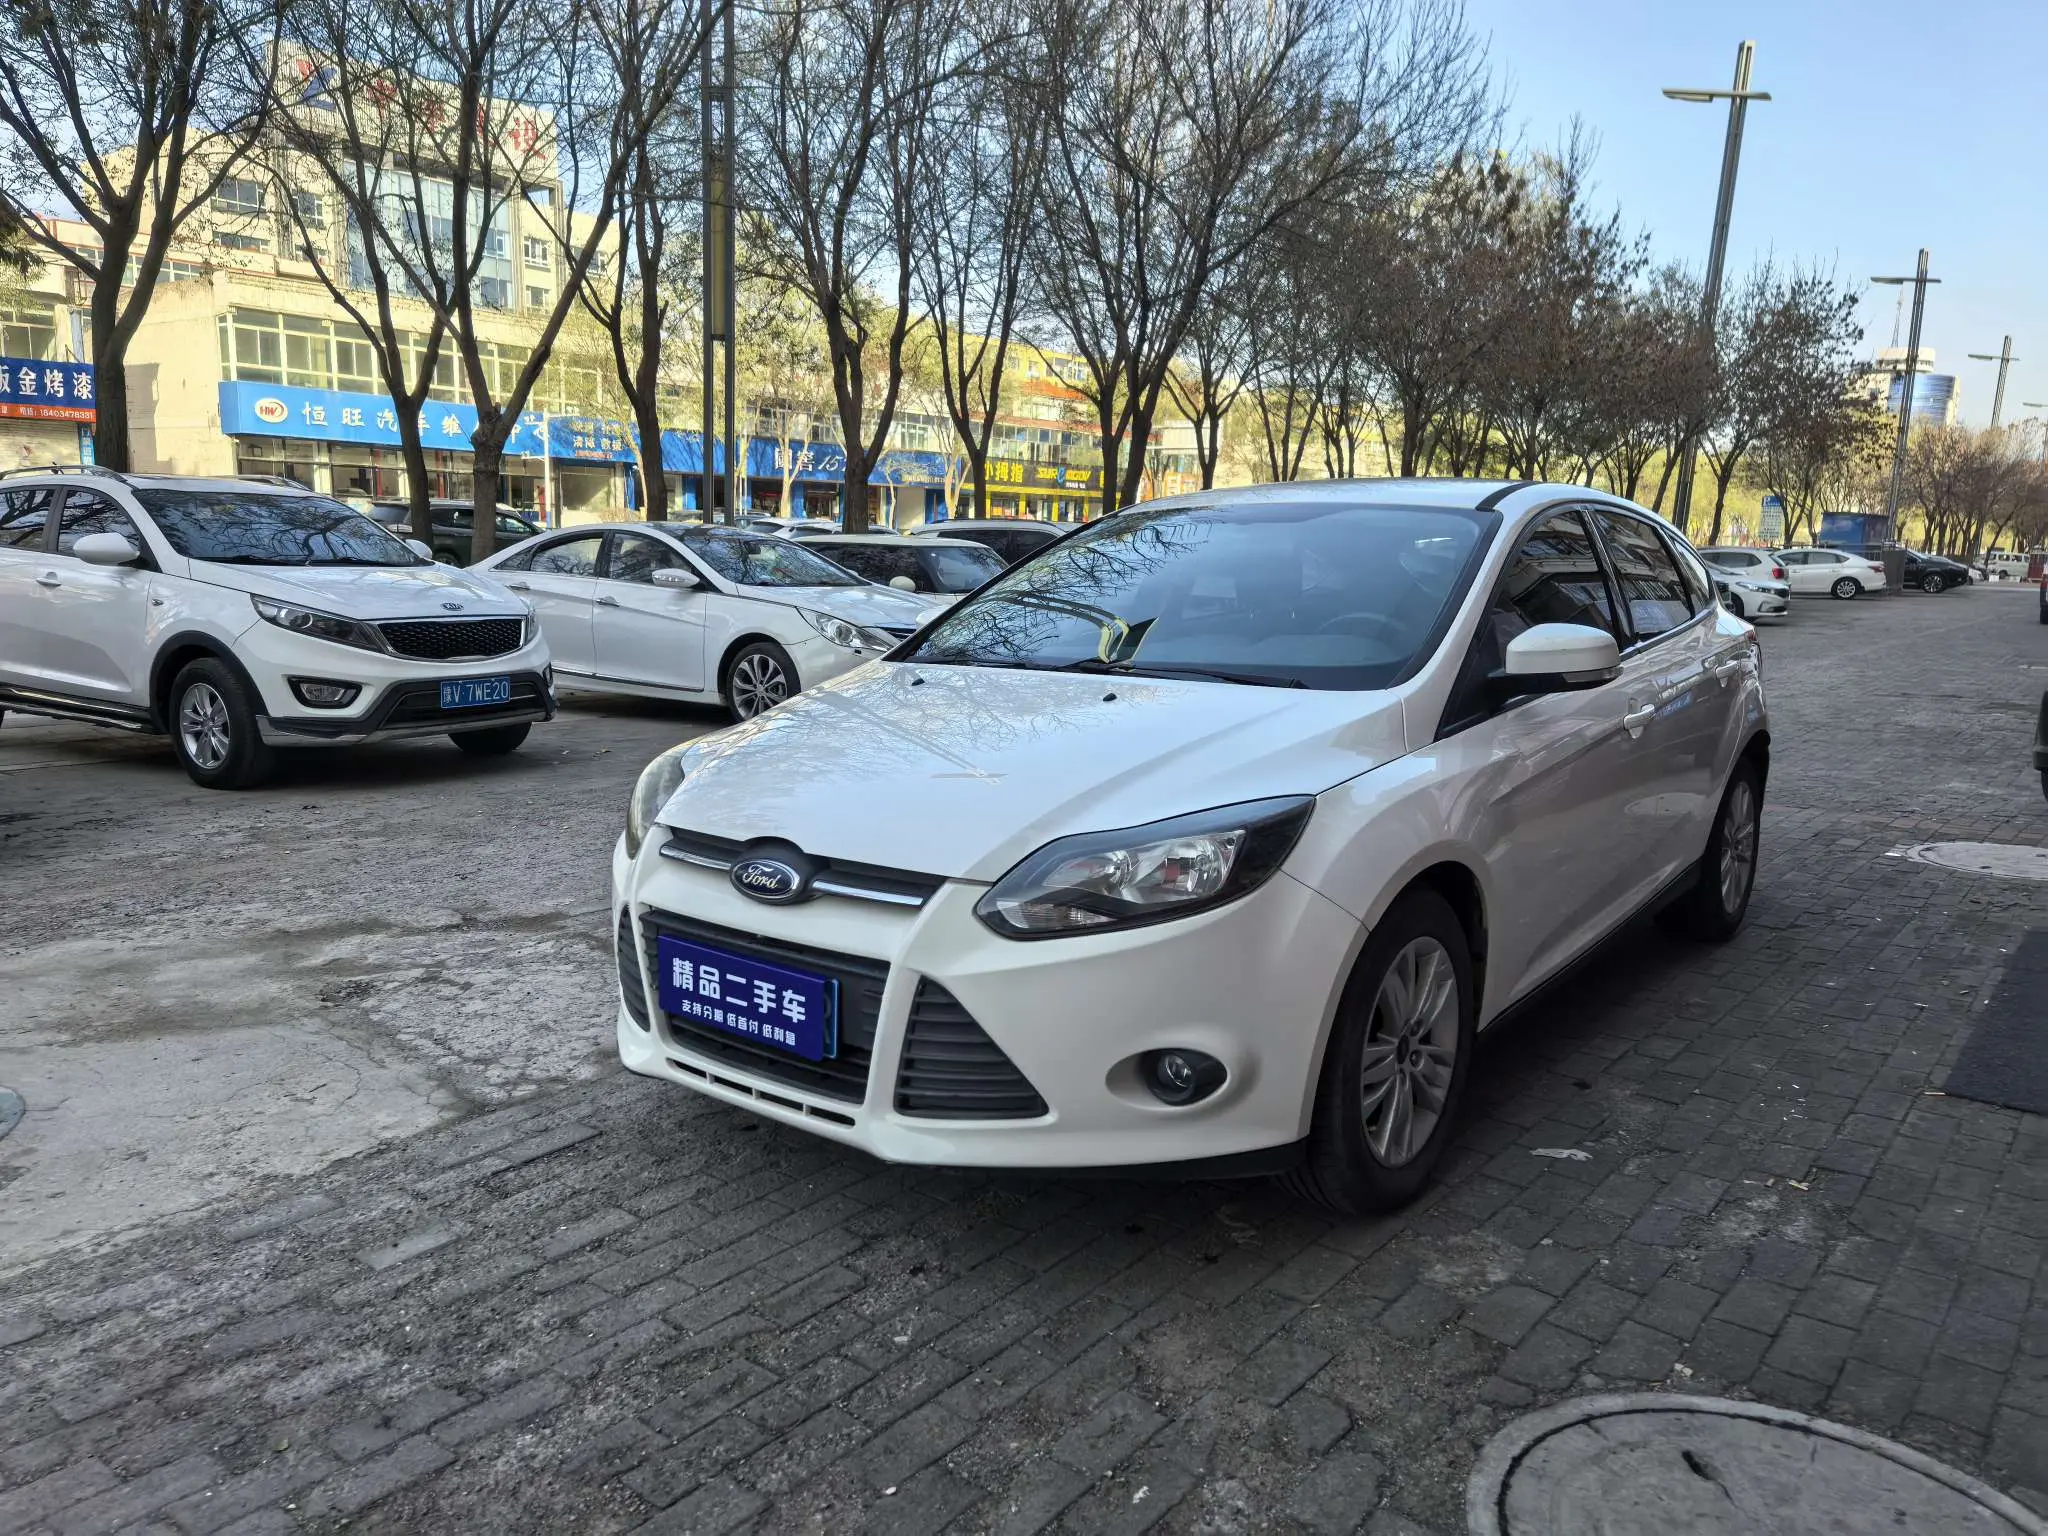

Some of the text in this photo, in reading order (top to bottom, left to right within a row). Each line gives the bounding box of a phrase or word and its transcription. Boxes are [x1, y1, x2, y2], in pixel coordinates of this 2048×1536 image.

[741, 863, 782, 889] Ford
[672, 957, 807, 1023] 精品二手车
[681, 999, 724, 1023] 支持分期
[726, 1012, 759, 1035] 低首付
